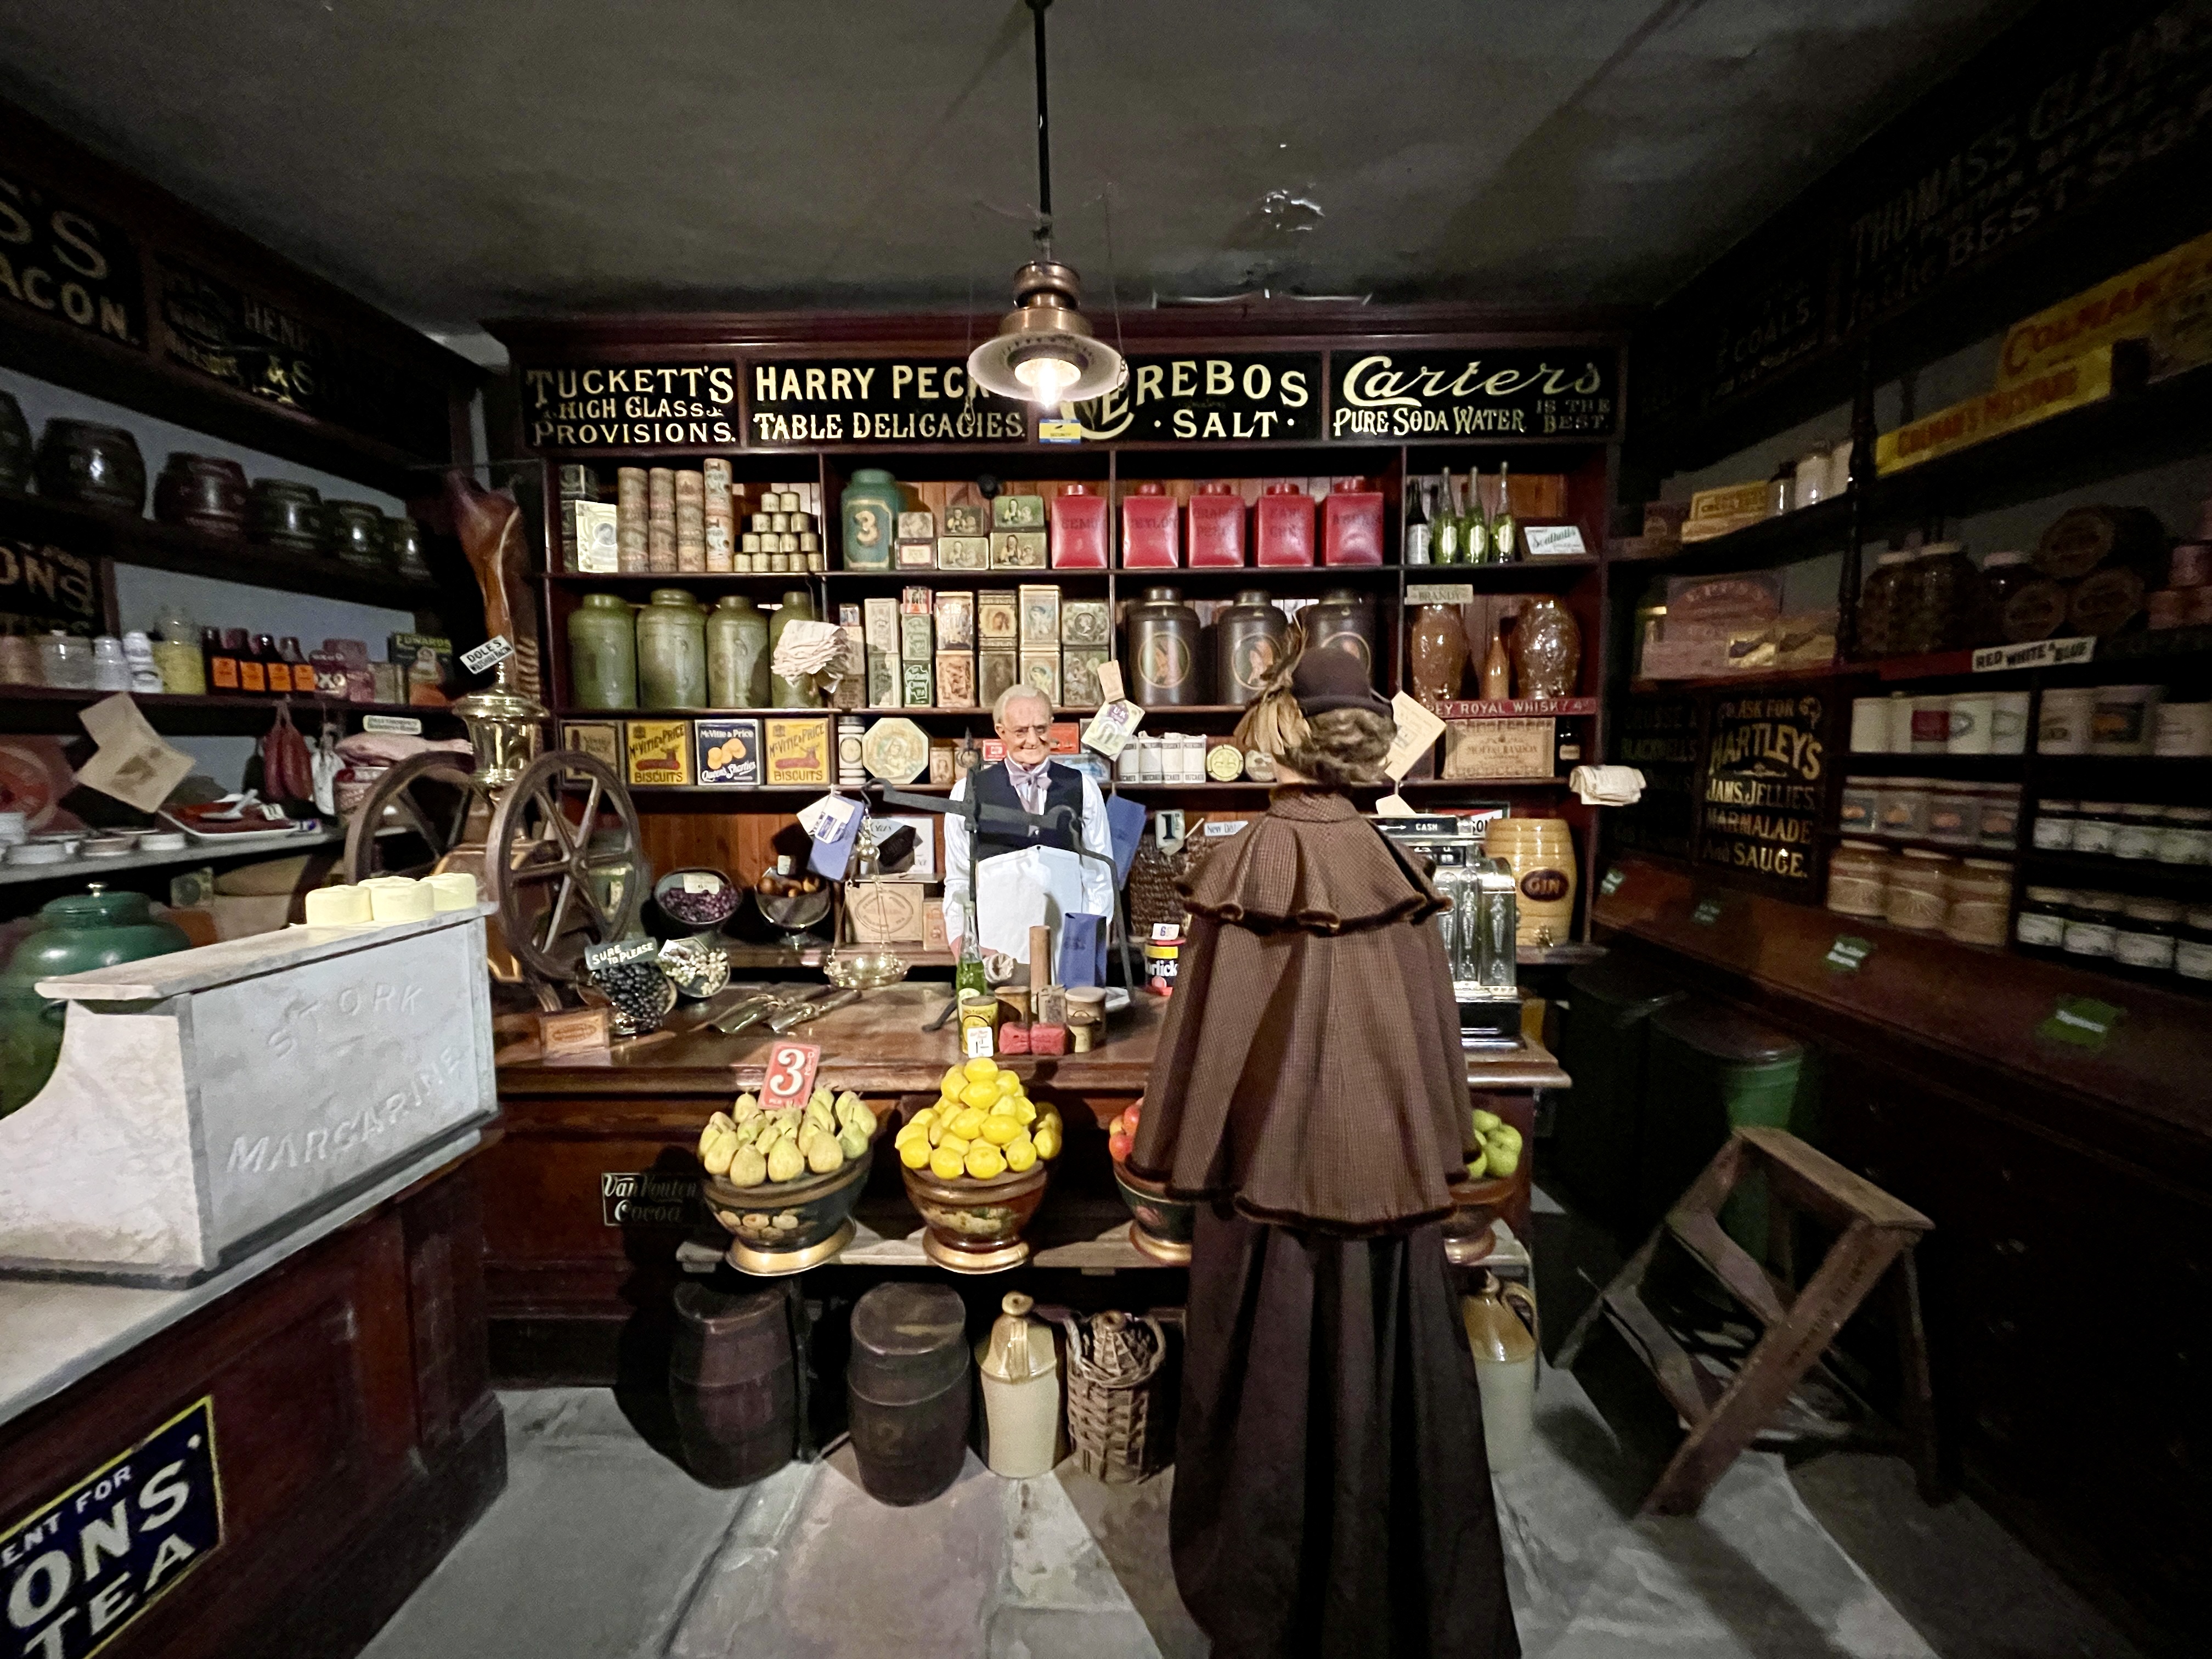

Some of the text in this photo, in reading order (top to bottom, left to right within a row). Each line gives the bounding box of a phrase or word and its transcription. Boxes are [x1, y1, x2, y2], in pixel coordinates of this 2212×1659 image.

[527, 366, 734, 408] TUCKETT'S
[756, 366, 876, 402] HARRY
[560, 398, 617, 420] HIGH
[1334, 405, 1526, 436] PURE SODA WATER
[532, 421, 736, 446] PROVISIONS.
[753, 413, 843, 441] TABLE
[1173, 409, 1278, 438] SALT
[855, 510, 879, 546] 3
[1976, 650, 2002, 668] RED
[1461, 702, 1506, 715] ROYAL
[663, 724, 685, 743] PRICE
[732, 729, 754, 738] Price
[802, 723, 825, 742] PRICE
[1708, 721, 1824, 781] HARTLEY'S
[635, 771, 683, 783] BISCUITS
[774, 770, 823, 781] BISCUITS
[1415, 823, 1438, 832] CASH
[1706, 807, 1813, 845] MARMALADE
[1528, 878, 1561, 894] GIN
[592, 945, 622, 965] SURE
[607, 942, 654, 965] TO PLEASE
[267, 984, 422, 1058] STORK
[770, 1048, 805, 1096] 3
[614, 1199, 682, 1223] Cocoa
[1, 1465, 132, 1568] ENT FOR
[7, 1459, 190, 1629] ONS
[22, 1533, 196, 1659] TEA
